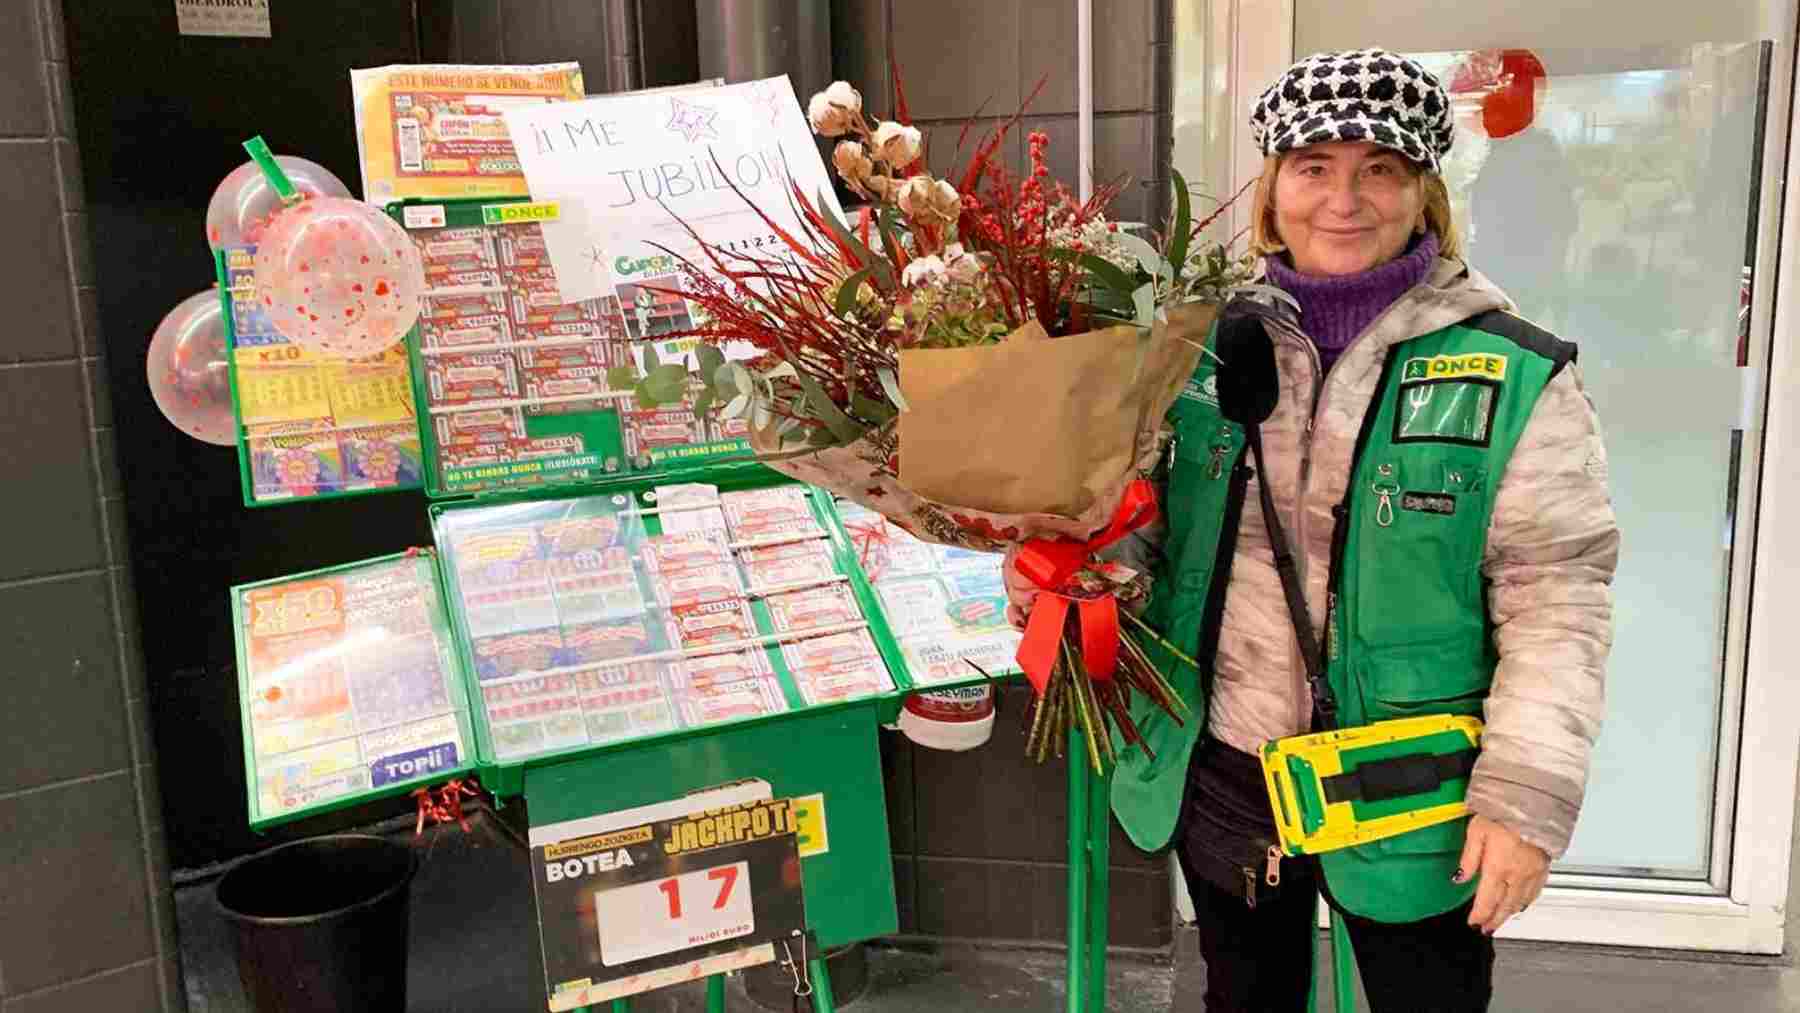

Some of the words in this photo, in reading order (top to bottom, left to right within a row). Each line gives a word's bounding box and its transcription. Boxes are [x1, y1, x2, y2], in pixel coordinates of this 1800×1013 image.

[564, 117, 625, 149] ME
[506, 206, 557, 219] ONCE
[1432, 358, 1498, 375] ONCE
[664, 801, 796, 854] JACKPOT
[546, 848, 634, 882] BOTEA
